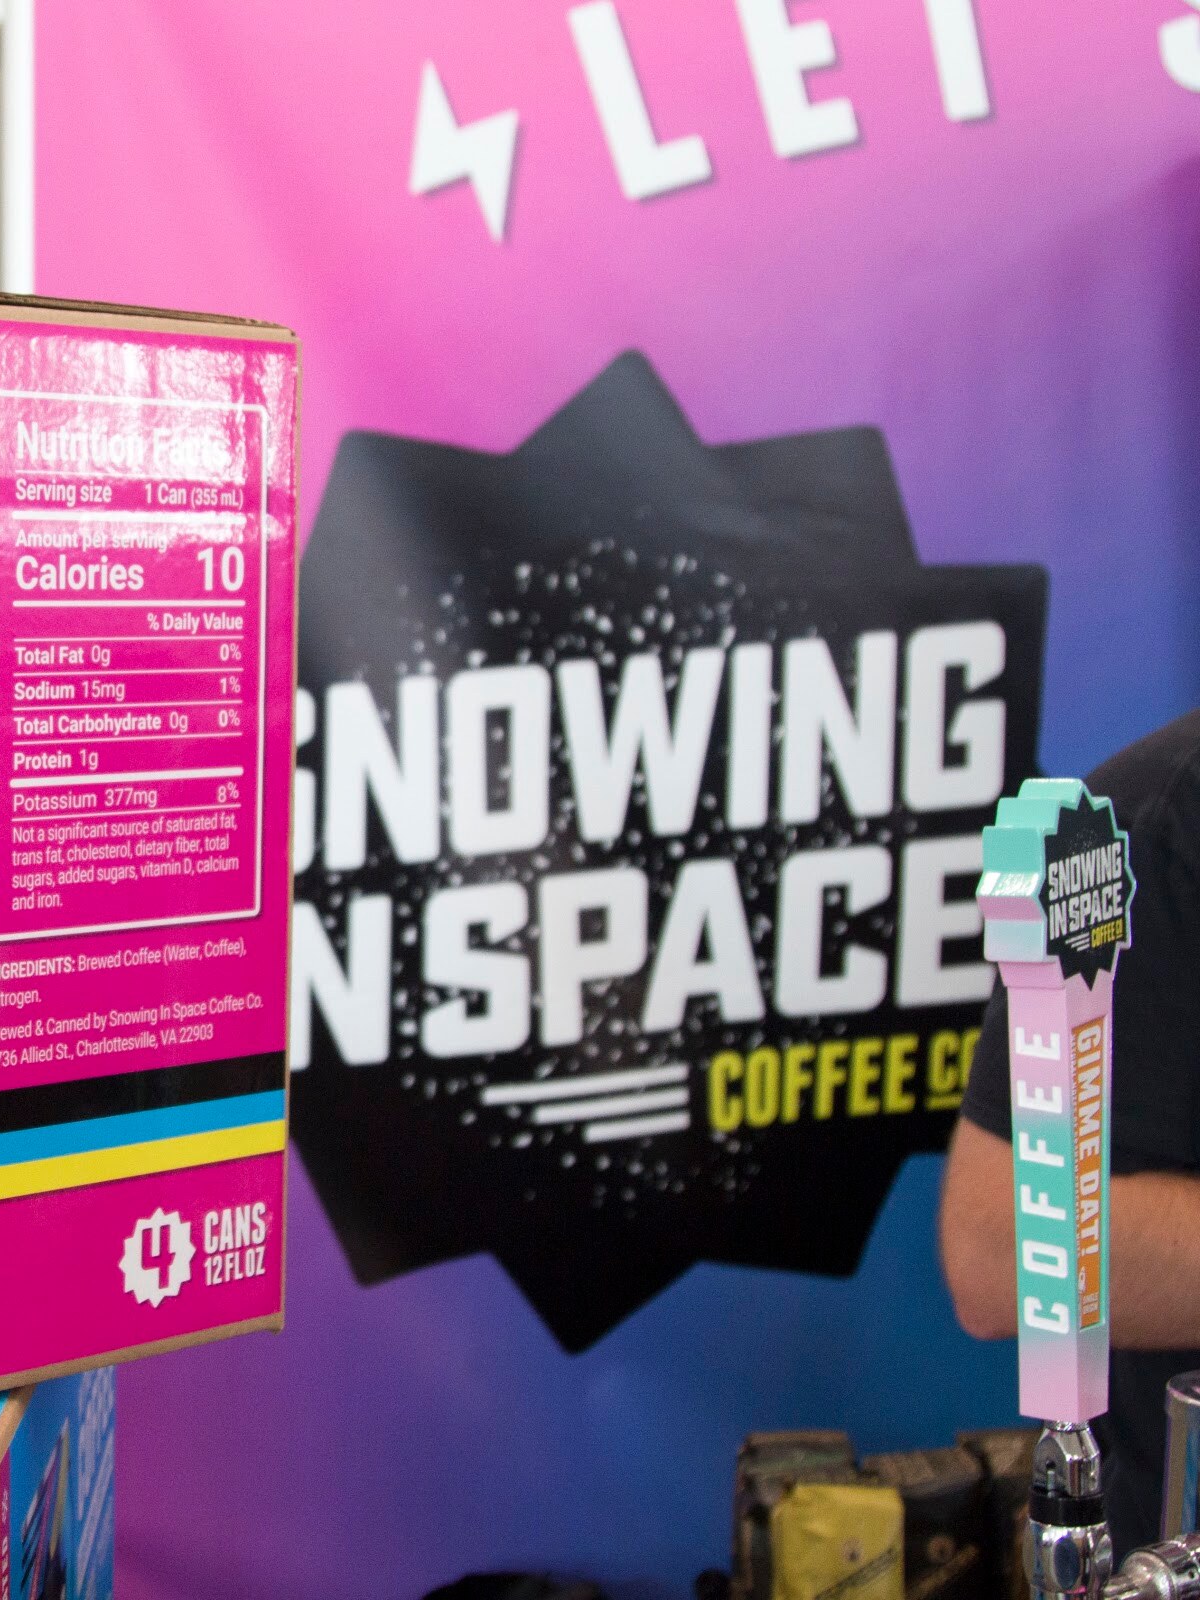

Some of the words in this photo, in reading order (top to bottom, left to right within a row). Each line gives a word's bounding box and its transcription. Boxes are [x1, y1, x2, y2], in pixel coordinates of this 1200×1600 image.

[16, 421, 143, 463] Nutrition
[15, 478, 76, 507] Serving
[80, 480, 112, 502] size
[157, 483, 187, 505] Can
[191, 488, 218, 510] (355
[220, 489, 244, 510] mL)
[15, 529, 78, 549] Amount
[82, 532, 108, 552] per
[112, 532, 168, 553] serving
[15, 554, 144, 590] Calories
[197, 546, 245, 592] 10
[163, 613, 200, 634] Daily
[203, 612, 243, 630] Value
[15, 645, 54, 665] Total
[59, 645, 84, 665] Fat
[91, 645, 111, 667] 0g
[220, 643, 242, 661] 0%
[14, 681, 75, 701] Sodium
[81, 680, 126, 702] 15mg
[220, 677, 241, 694] 1%
[14, 716, 54, 736] Total
[58, 713, 162, 736] Carbohydrate
[169, 711, 188, 733] 0g
[218, 710, 240, 727] 0%
[13, 750, 72, 770] Protein
[80, 749, 99, 771] 1g
[295, 620, 1006, 874] NOWING
[13, 791, 97, 812] Potassium
[104, 787, 158, 808] 377mg
[217, 782, 239, 803] 8%
[13, 826, 34, 843] Not
[48, 821, 108, 844] significant
[111, 821, 149, 837] source
[152, 816, 164, 834] of
[166, 813, 218, 832] saturated
[220, 811, 238, 831] fat,
[12, 851, 43, 866] trans
[67, 839, 133, 862] cholesterol,
[135, 838, 174, 858] dietary
[204, 833, 230, 851] total
[12, 873, 55, 891] sugars,
[58, 865, 94, 884] added
[97, 865, 138, 884] sugars,
[140, 859, 180, 878] vitamin
[197, 855, 239, 874] calcium
[1048, 841, 1122, 901] SNOWING
[12, 892, 34, 911] and
[37, 890, 63, 908] iron.
[1049, 901, 1068, 941] IN
[1068, 882, 1123, 932] SPACE
[422, 833, 998, 1058] SPACE
[1091, 921, 1115, 948] COFFEE
[78, 950, 121, 972] Brewed
[124, 947, 161, 967] Coffee
[163, 944, 202, 966] (Water,
[46, 1012, 91, 1035] Canned
[93, 1012, 107, 1033] by
[109, 1007, 158, 1027] Snowing
[172, 1002, 207, 1022] Space
[209, 994, 244, 1014] Coffee
[20, 1044, 53, 1065] Allied
[76, 1030, 158, 1057] Charlottesville,
[160, 1029, 177, 1046] VA
[180, 1023, 214, 1044] 22903
[710, 1035, 915, 1131] COFFEE
[1077, 1024, 1101, 1160] GIMME
[1015, 1026, 1070, 1335] COFFEE
[204, 1202, 266, 1254] CANS
[1080, 1168, 1100, 1256] DAT!
